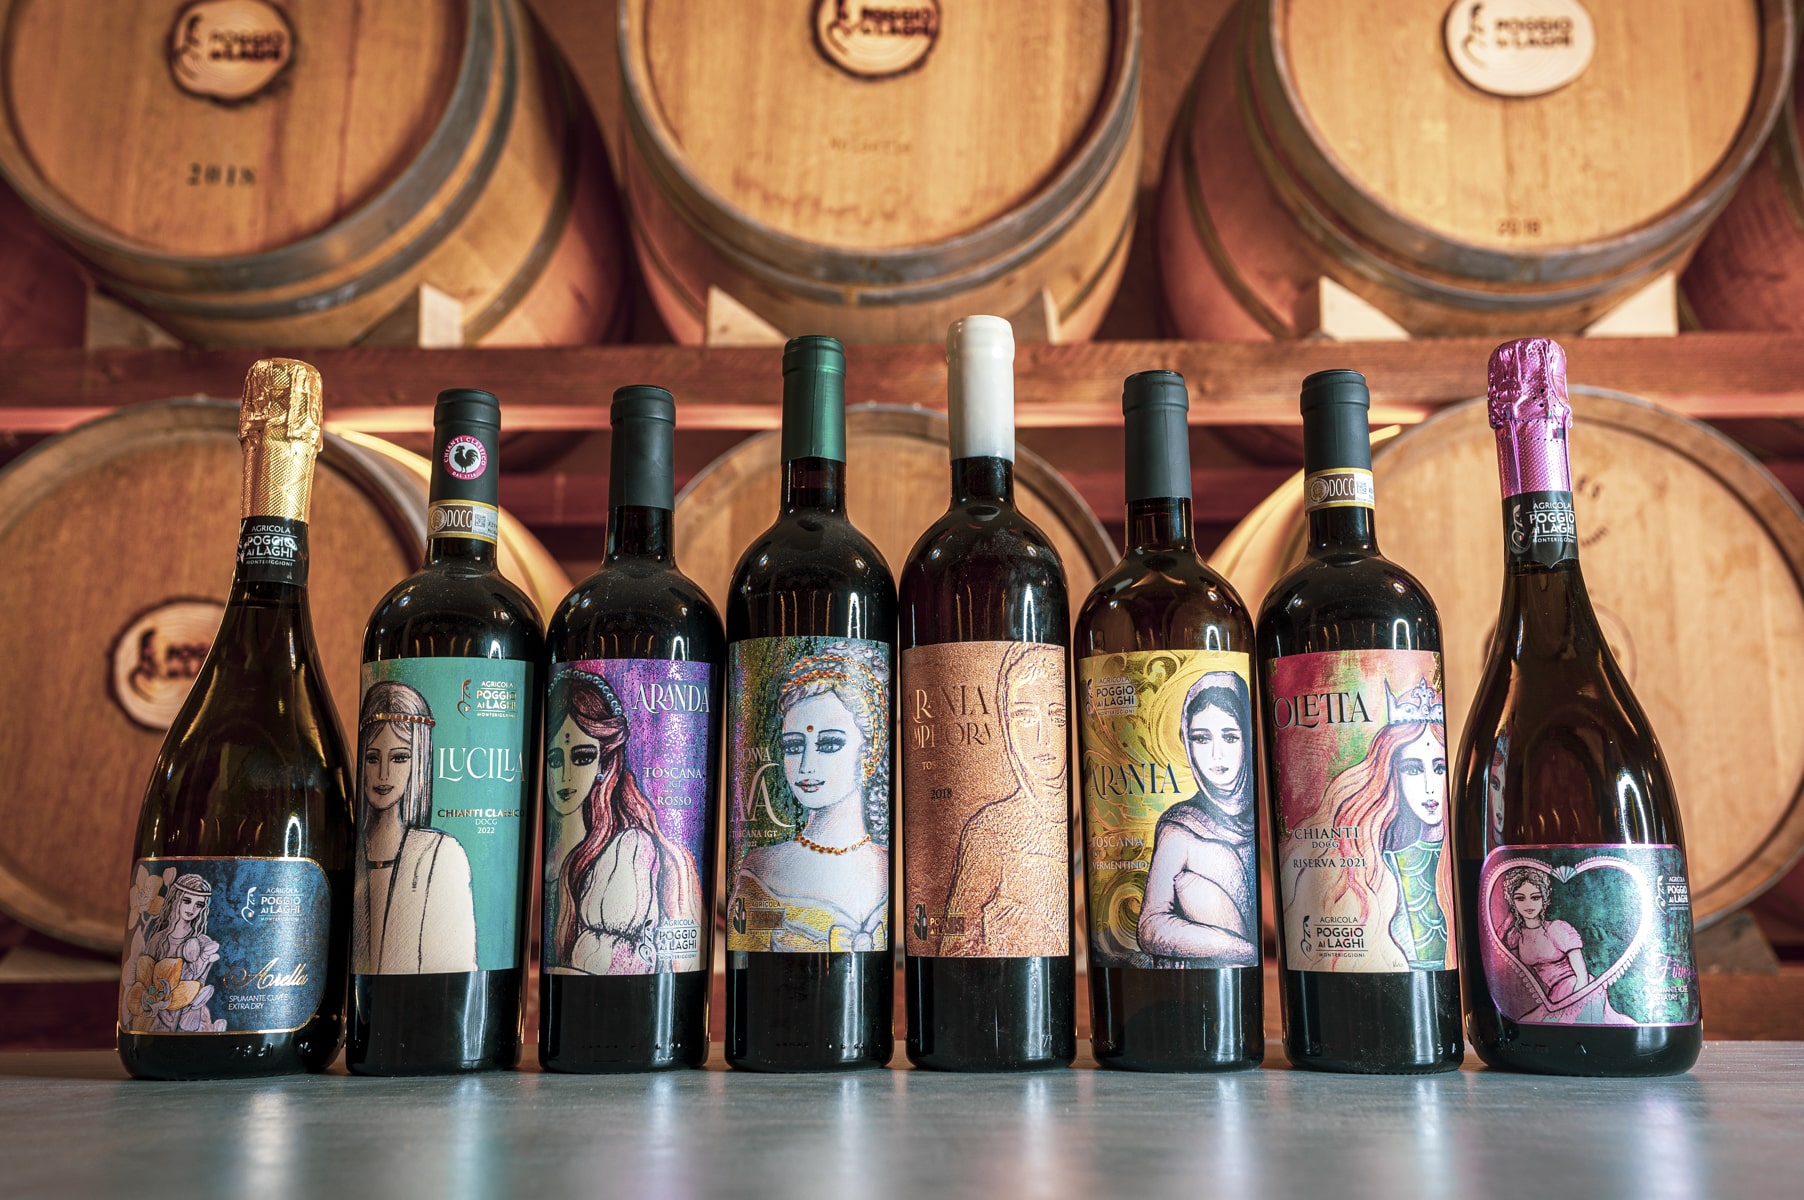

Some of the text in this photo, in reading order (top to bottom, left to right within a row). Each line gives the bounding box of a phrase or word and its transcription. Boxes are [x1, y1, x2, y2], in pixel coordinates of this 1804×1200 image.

[443, 436, 464, 463] CHIANTI
[1328, 477, 1355, 497] DOCG
[1533, 501, 1572, 510] AGRICOLA
[446, 508, 473, 528] DOCG
[1529, 511, 1575, 524] POGGIO
[251, 524, 291, 535] AGRICOLA
[1541, 522, 1574, 535] LAGHI
[247, 534, 297, 549] POGGIO
[256, 545, 294, 559] LAGHI
[481, 680, 514, 688] AGRICOLA
[1100, 675, 1132, 685] AGRICOLA
[476, 689, 517, 701] POGGIO
[1096, 685, 1135, 698] POGGIO
[632, 682, 711, 714] ARANDA
[1104, 695, 1135, 707] LAGHI
[486, 699, 516, 710] LAGHI
[438, 746, 526, 782] LUCILLA
[643, 767, 703, 780] TOSCANA
[1089, 762, 1183, 801] ARANIA
[931, 787, 953, 800] 2018
[657, 795, 692, 806] ROSSO
[436, 807, 483, 818] CHIANTI
[475, 818, 498, 826] DOCG
[477, 826, 495, 834] 2022
[763, 829, 778, 838] IGT
[1294, 826, 1360, 840] CHIANTI
[1091, 834, 1145, 848] TOSCANA
[1311, 840, 1339, 849] DOCG
[1092, 860, 1149, 871] VERMENTINO
[1293, 857, 1366, 868] RISERVA 2021
[260, 896, 301, 905] POGGIO
[270, 905, 300, 914] LAGHI
[664, 918, 695, 927] AGRICOLA
[1320, 916, 1358, 924] AGRICOLA
[660, 929, 698, 940] POGGIO
[1316, 927, 1364, 938] POGGIO
[669, 939, 697, 951] LAGHI
[1327, 938, 1364, 949] LAGHI
[228, 993, 266, 1002] SPUMANTE
[228, 1002, 265, 1011] EXTRA DRY
